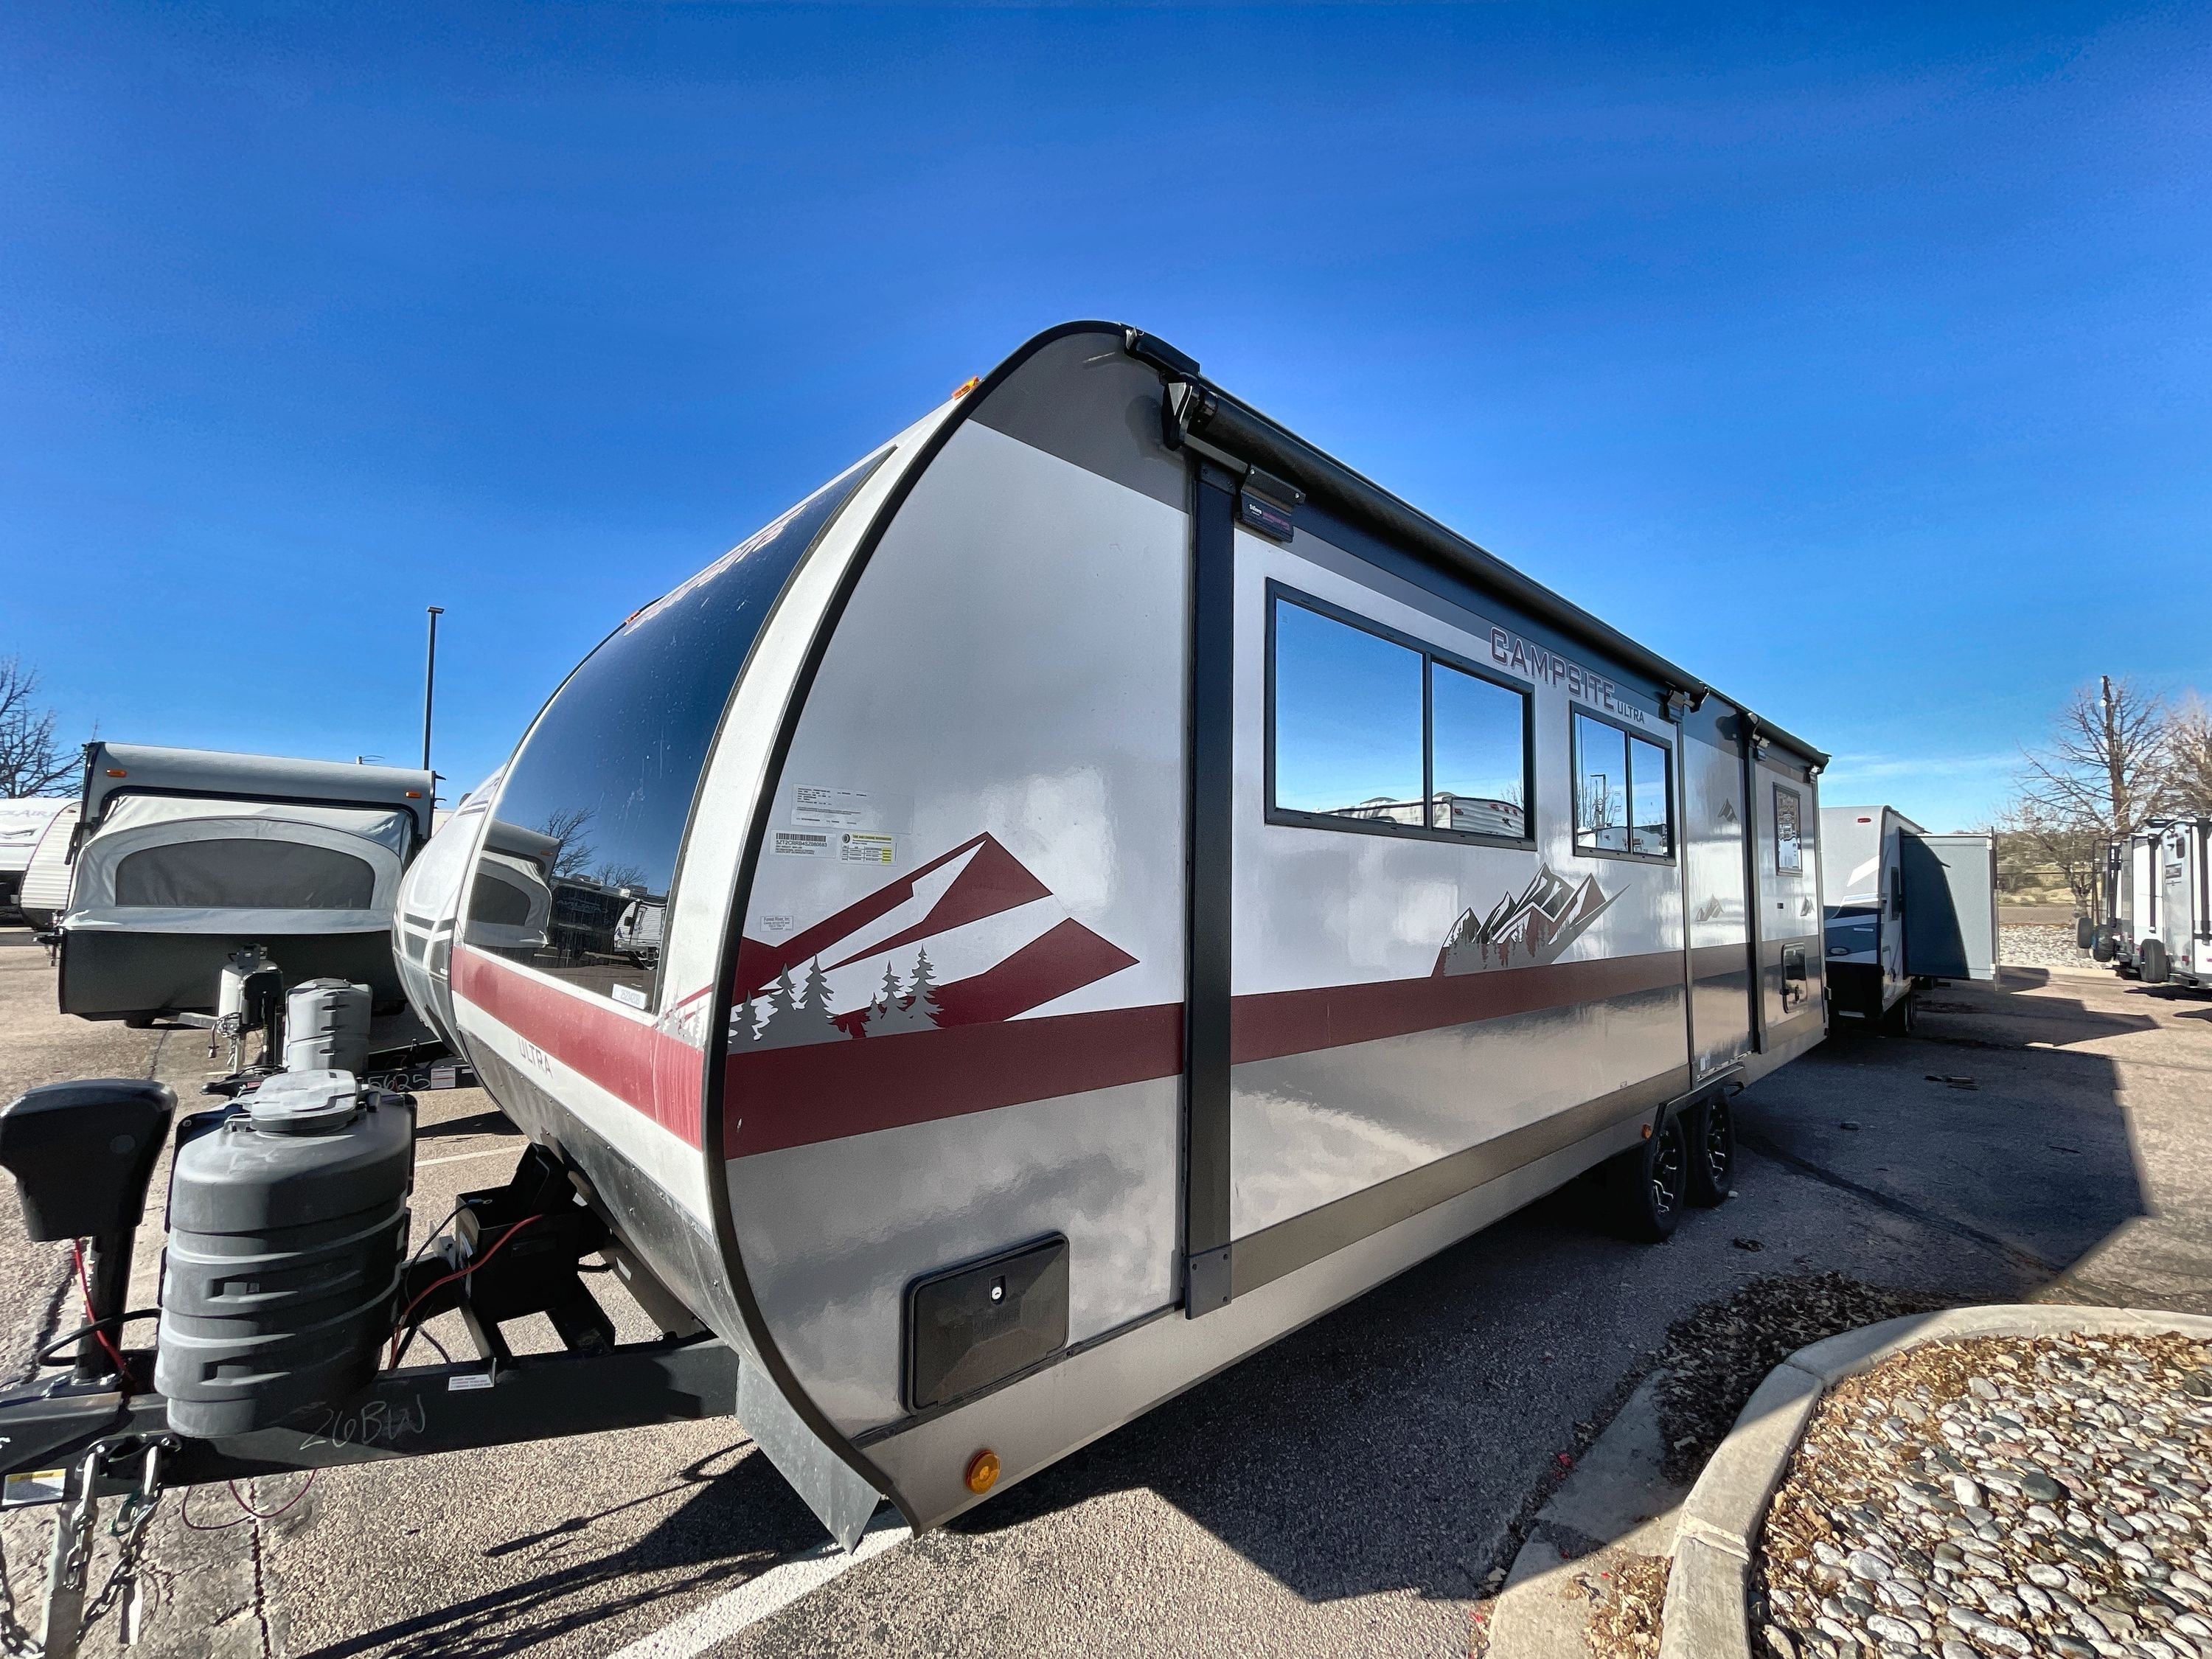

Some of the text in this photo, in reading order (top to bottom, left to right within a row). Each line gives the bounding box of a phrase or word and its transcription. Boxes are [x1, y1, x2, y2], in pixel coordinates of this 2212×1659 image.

[1490, 627, 1615, 712] CAMPSITE
[1617, 701, 1645, 724] ULTRA
[518, 1037, 554, 1079] ULTRA
